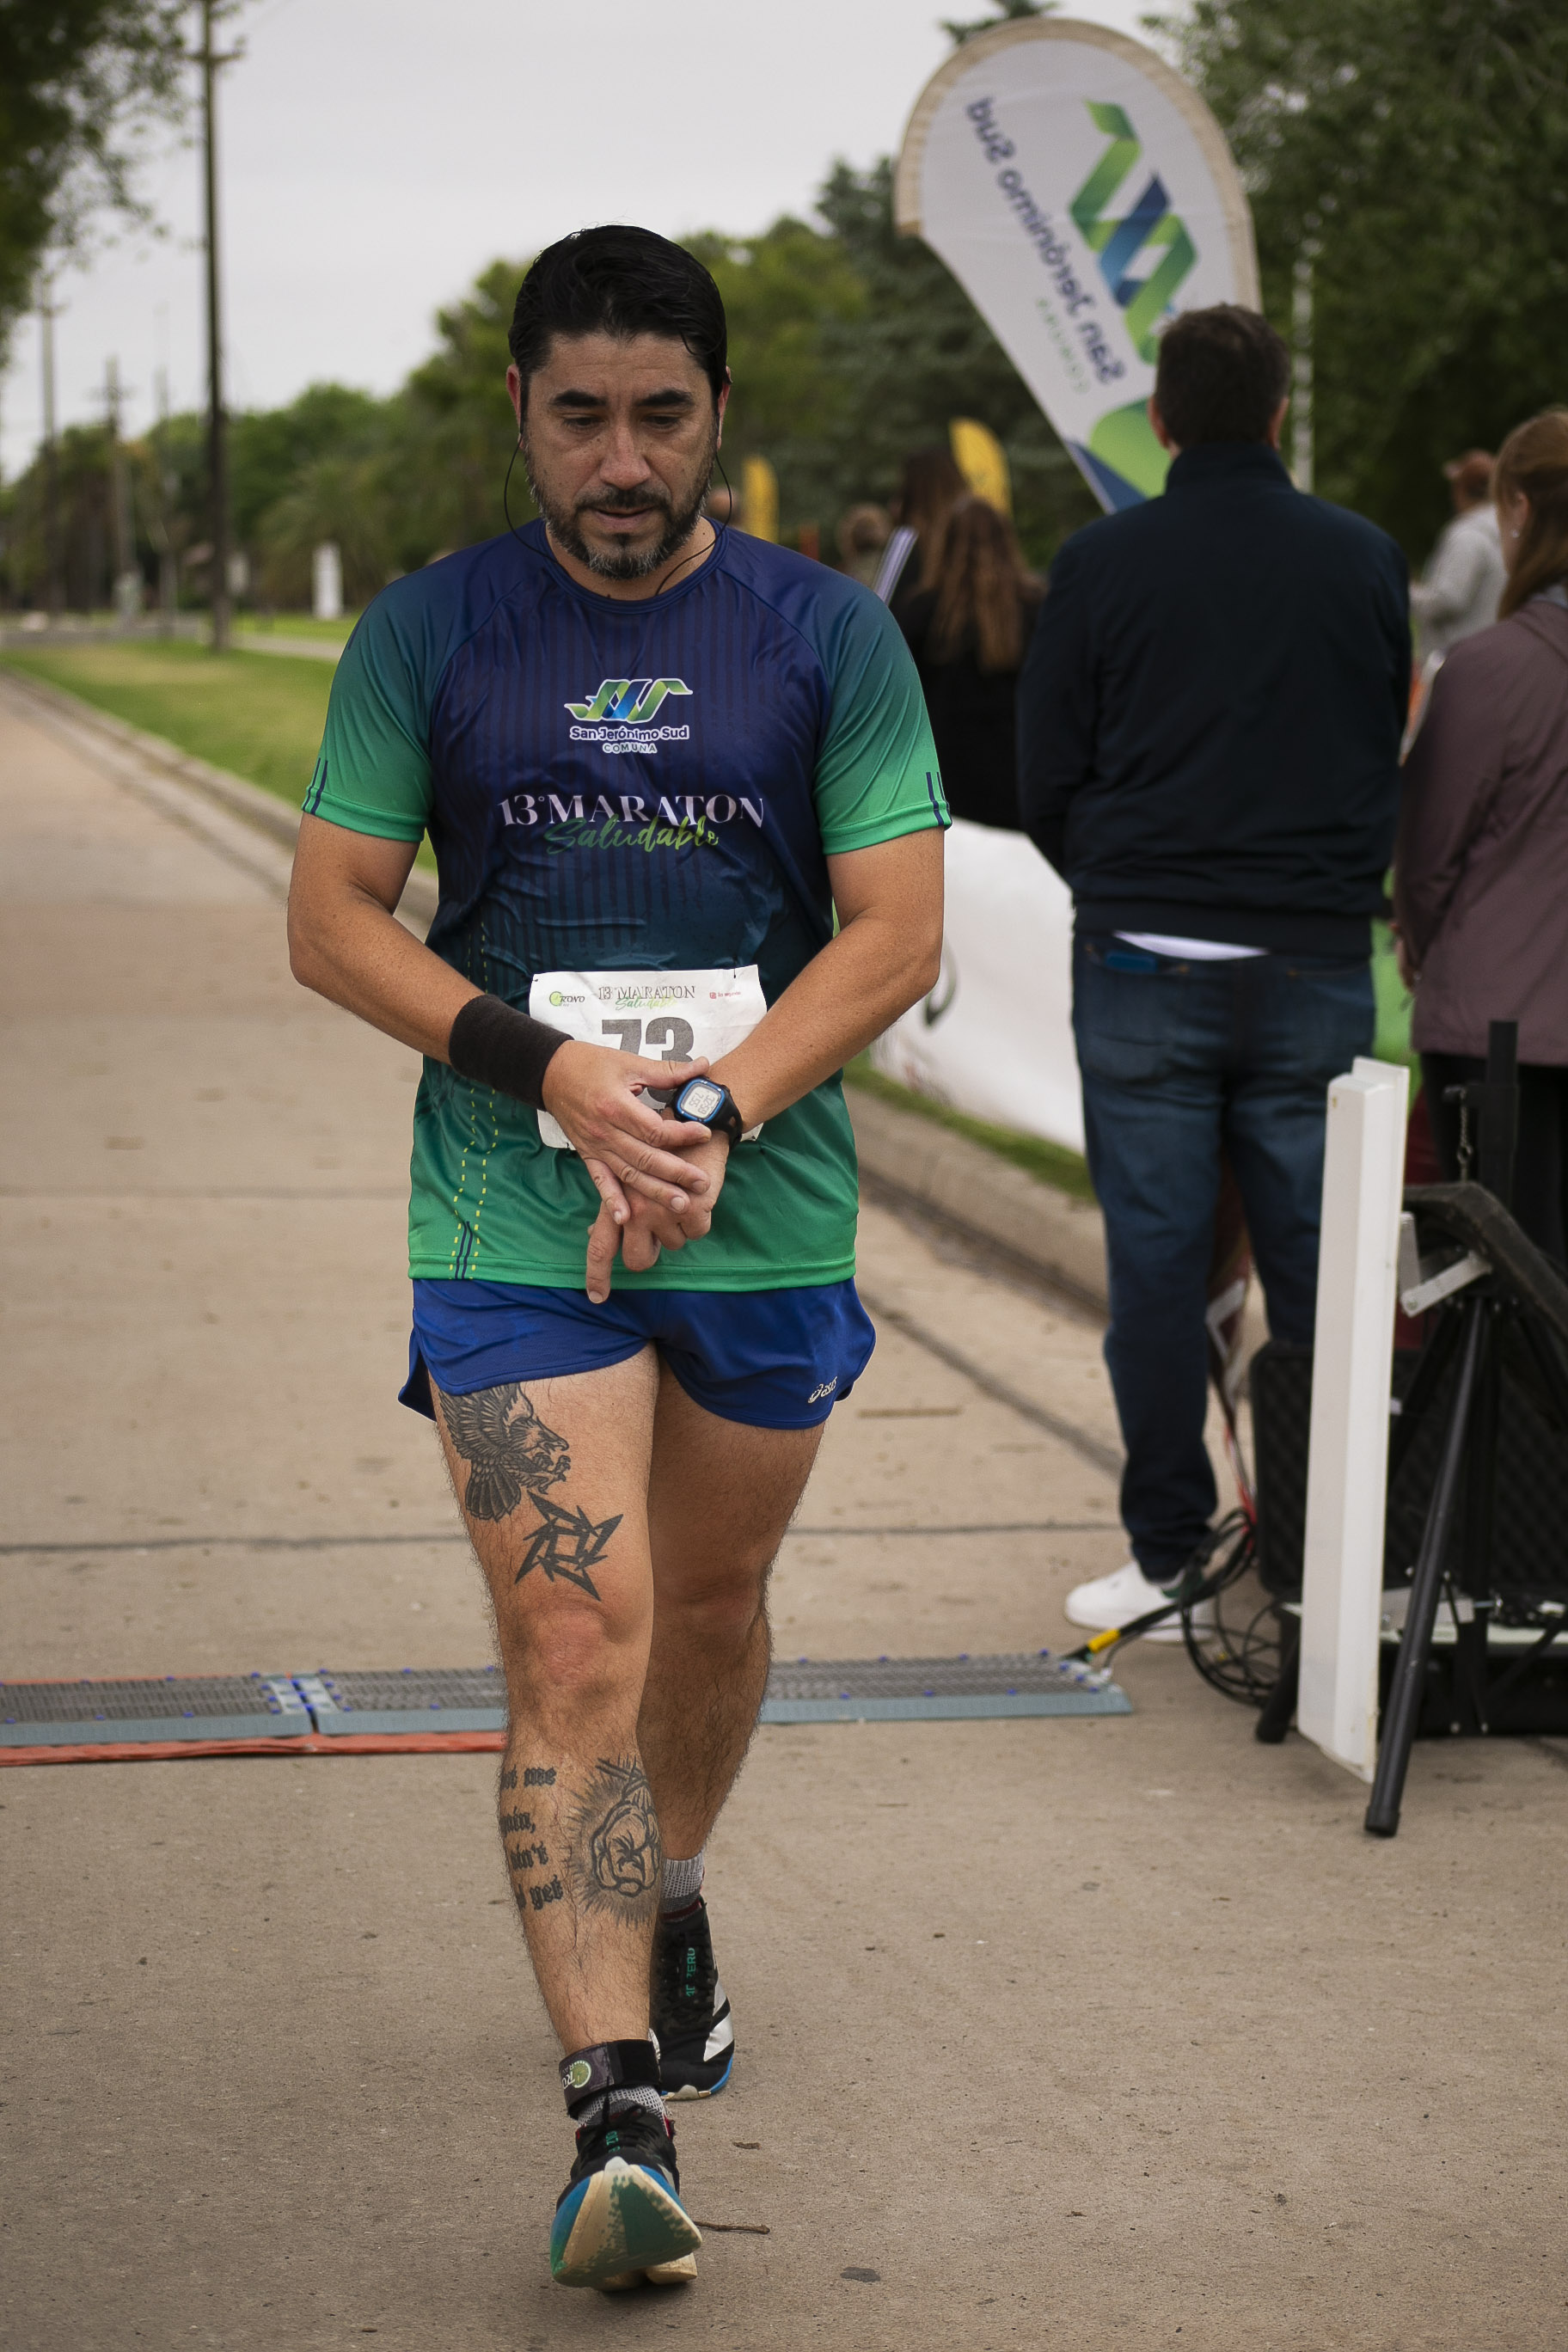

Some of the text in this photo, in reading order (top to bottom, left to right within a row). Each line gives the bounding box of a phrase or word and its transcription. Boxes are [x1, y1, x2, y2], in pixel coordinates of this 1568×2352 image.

[570, 725, 689, 742] San Jerónimo Sud
[603, 743, 658, 753] COMUNA
[548, 793, 764, 828] MARATON
[543, 813, 719, 854] Saludable
[617, 985, 695, 999] MARATON
